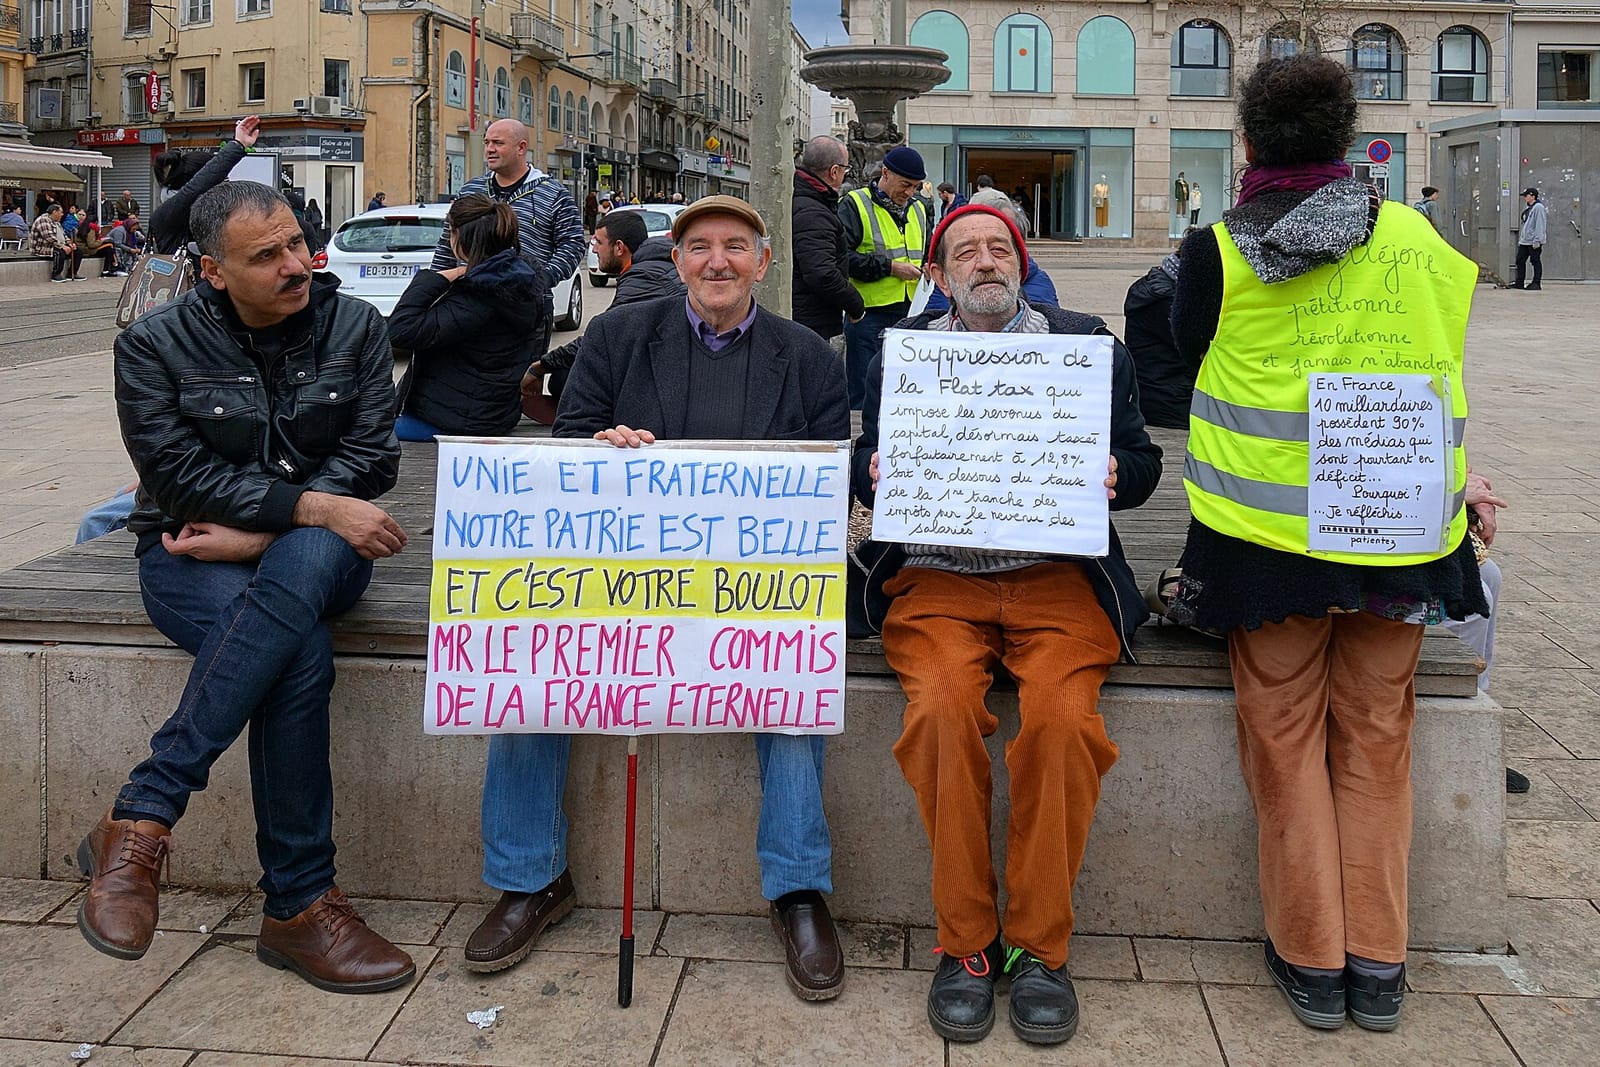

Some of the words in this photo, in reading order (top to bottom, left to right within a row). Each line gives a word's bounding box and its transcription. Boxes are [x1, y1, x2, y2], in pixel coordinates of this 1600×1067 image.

[81, 134, 95, 143] BAR
[1288, 297, 1407, 332] pétitionne
[1290, 324, 1411, 346] révolutionne
[899, 337, 1049, 377] Suppression
[1063, 348, 1093, 367] de
[1262, 353, 1279, 368] et
[1290, 354, 1351, 378] jamais
[894, 374, 923, 394] la
[940, 377, 982, 395] Flat
[988, 379, 1034, 397] tax
[1046, 385, 1082, 406] qui
[1317, 378, 1338, 391] En
[1342, 377, 1402, 399] France,
[1315, 398, 1331, 412] 10
[1336, 394, 1432, 412] milliardaires
[890, 404, 949, 429] impose
[954, 405, 975, 418] les
[980, 406, 1042, 419] revenus
[1053, 407, 1077, 419] du
[1317, 414, 1385, 436] possèdent
[890, 424, 953, 447] capital,
[956, 426, 1039, 442] désormais
[1047, 431, 1099, 445] taxés
[1317, 438, 1341, 449] des
[1345, 432, 1405, 448] médias
[1409, 435, 1432, 455] qui
[887, 446, 1003, 466] forfaitairement
[1012, 452, 1026, 463] à
[1031, 452, 1085, 468] 12,8%
[1315, 453, 1348, 465] sont
[1354, 452, 1413, 471] pourtant
[559, 460, 608, 495] ET
[625, 459, 839, 498] FRATERNELLE
[924, 468, 943, 480] en
[947, 468, 1000, 483] dessous
[1011, 472, 1032, 484] du
[1041, 475, 1087, 486] taux
[884, 486, 907, 499] de
[913, 487, 932, 501] la
[965, 490, 1024, 507] tranche
[1033, 494, 1057, 507] des
[1352, 485, 1409, 508] Pourquoi
[885, 505, 931, 524] impôts
[935, 508, 960, 519] sur
[969, 507, 986, 520] le
[991, 511, 1043, 523] revenu
[1049, 517, 1075, 527] des
[445, 509, 534, 548] NOTRE
[659, 513, 725, 555] EST
[738, 516, 839, 557] BELLE
[1351, 536, 1396, 551] patientez
[448, 568, 491, 614] ET
[495, 562, 594, 611] C'EST
[603, 567, 696, 608] VOTRE
[714, 567, 838, 616] BOULOT
[434, 623, 472, 673] MR
[484, 624, 520, 674] LE
[436, 683, 476, 728] DE
[484, 684, 525, 728] LA
[544, 679, 657, 730] FRANCE
[666, 682, 839, 729] ETERNELLE
